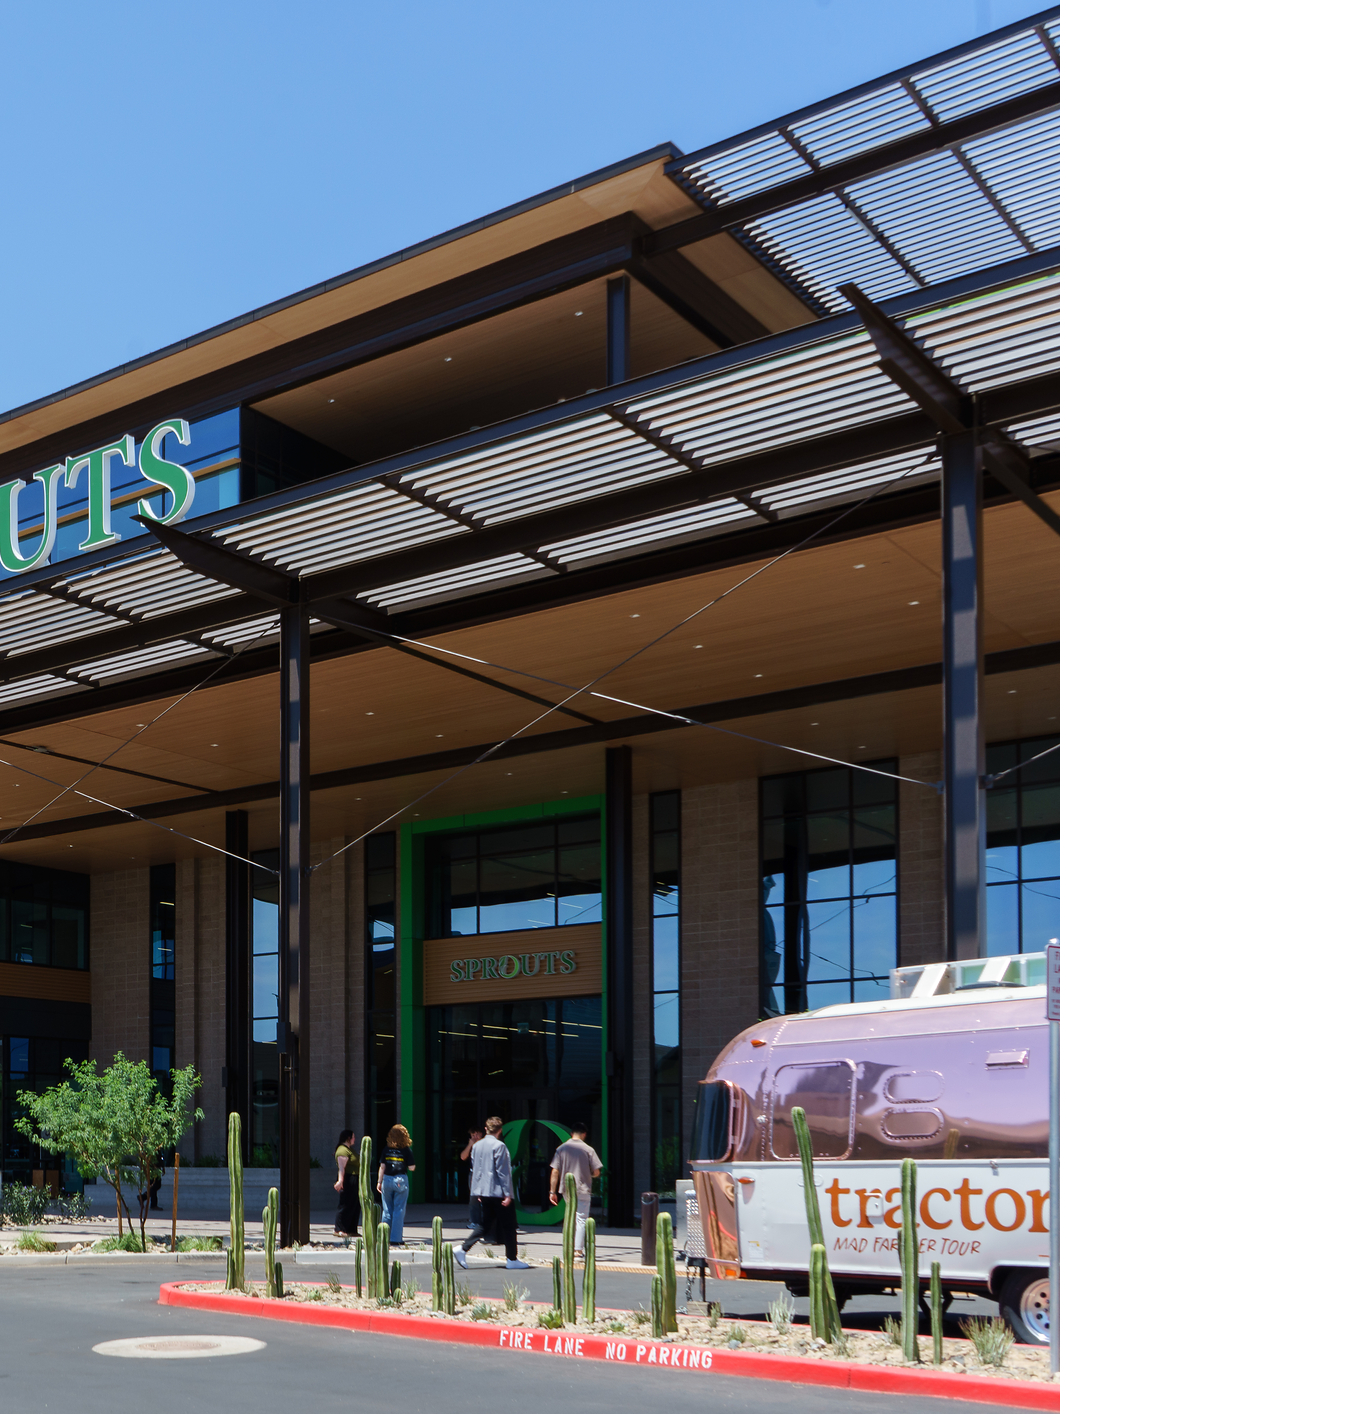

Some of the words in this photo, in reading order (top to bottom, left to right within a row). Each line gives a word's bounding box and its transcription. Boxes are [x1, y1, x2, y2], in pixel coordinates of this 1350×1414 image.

[450, 950, 576, 982] SPROUTS
[833, 1236, 868, 1253] MAD
[873, 1236, 937, 1254] FARER
[940, 1237, 982, 1256] TOUR
[500, 1329, 534, 1350] FIRE
[544, 1335, 585, 1357] LANE
[605, 1342, 627, 1361] NO
[636, 1345, 713, 1369] PARKING
